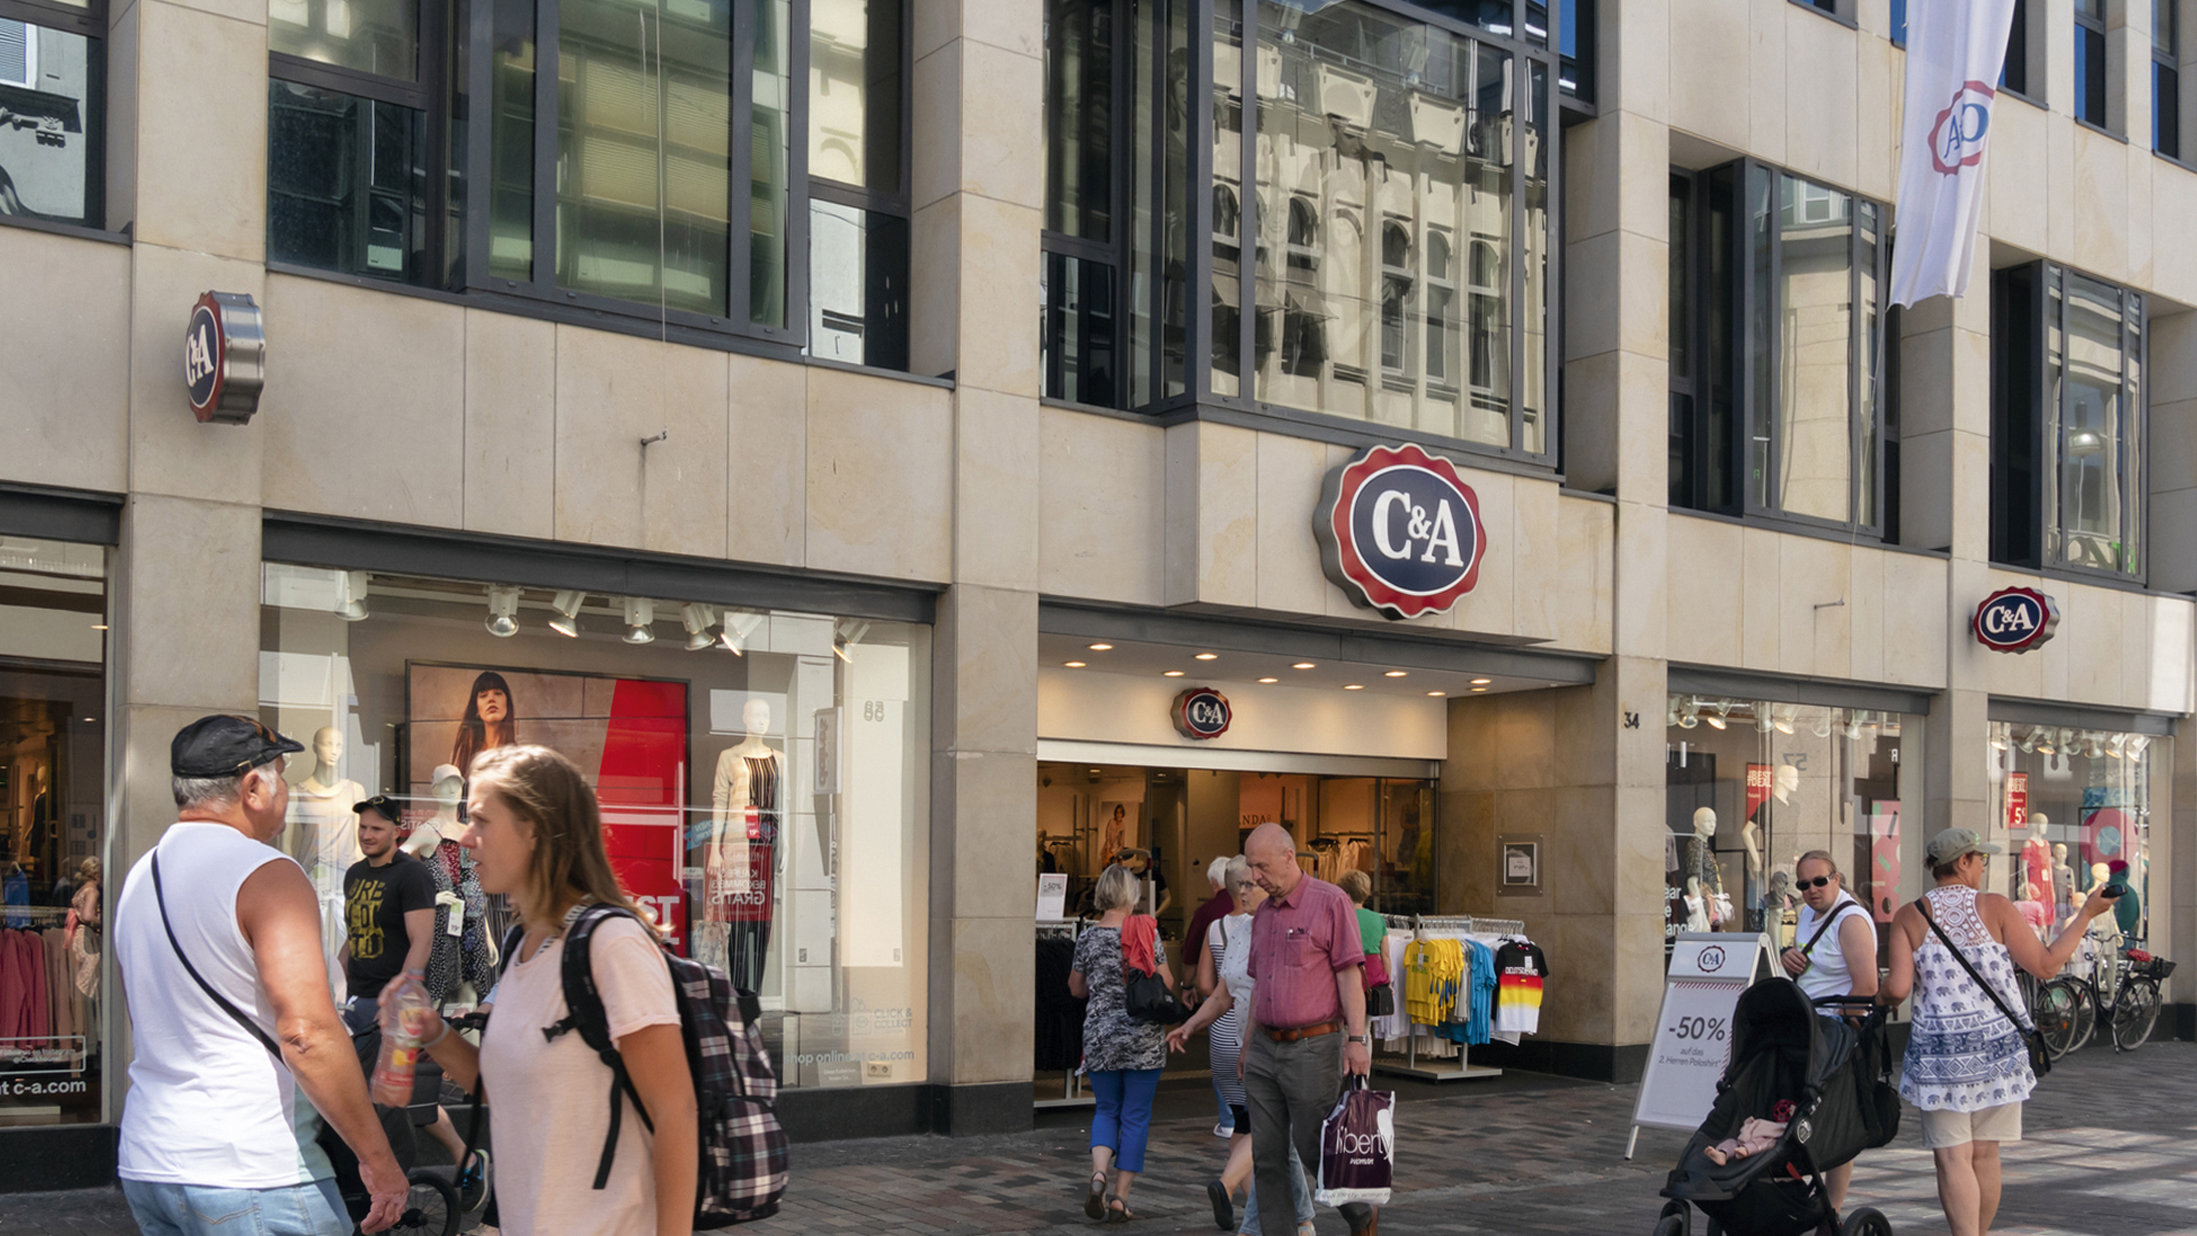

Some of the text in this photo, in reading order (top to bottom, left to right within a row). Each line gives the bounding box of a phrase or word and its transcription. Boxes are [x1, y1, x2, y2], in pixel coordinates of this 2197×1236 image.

[1372, 489, 1464, 567] C&A
[1986, 603, 2034, 634] C&A
[1192, 701, 1224, 725] C&A
[1623, 711, 1640, 730] 34
[1239, 814, 1266, 825] NDA
[1664, 887, 1682, 900] ear
[873, 1007, 904, 1018] CLICK
[1668, 1016, 1726, 1041] -50%
[815, 1050, 851, 1063] online
[868, 1050, 915, 1062] c-a.com
[1692, 1048, 1704, 1056] das
[13, 1080, 87, 1095] c-a.com
